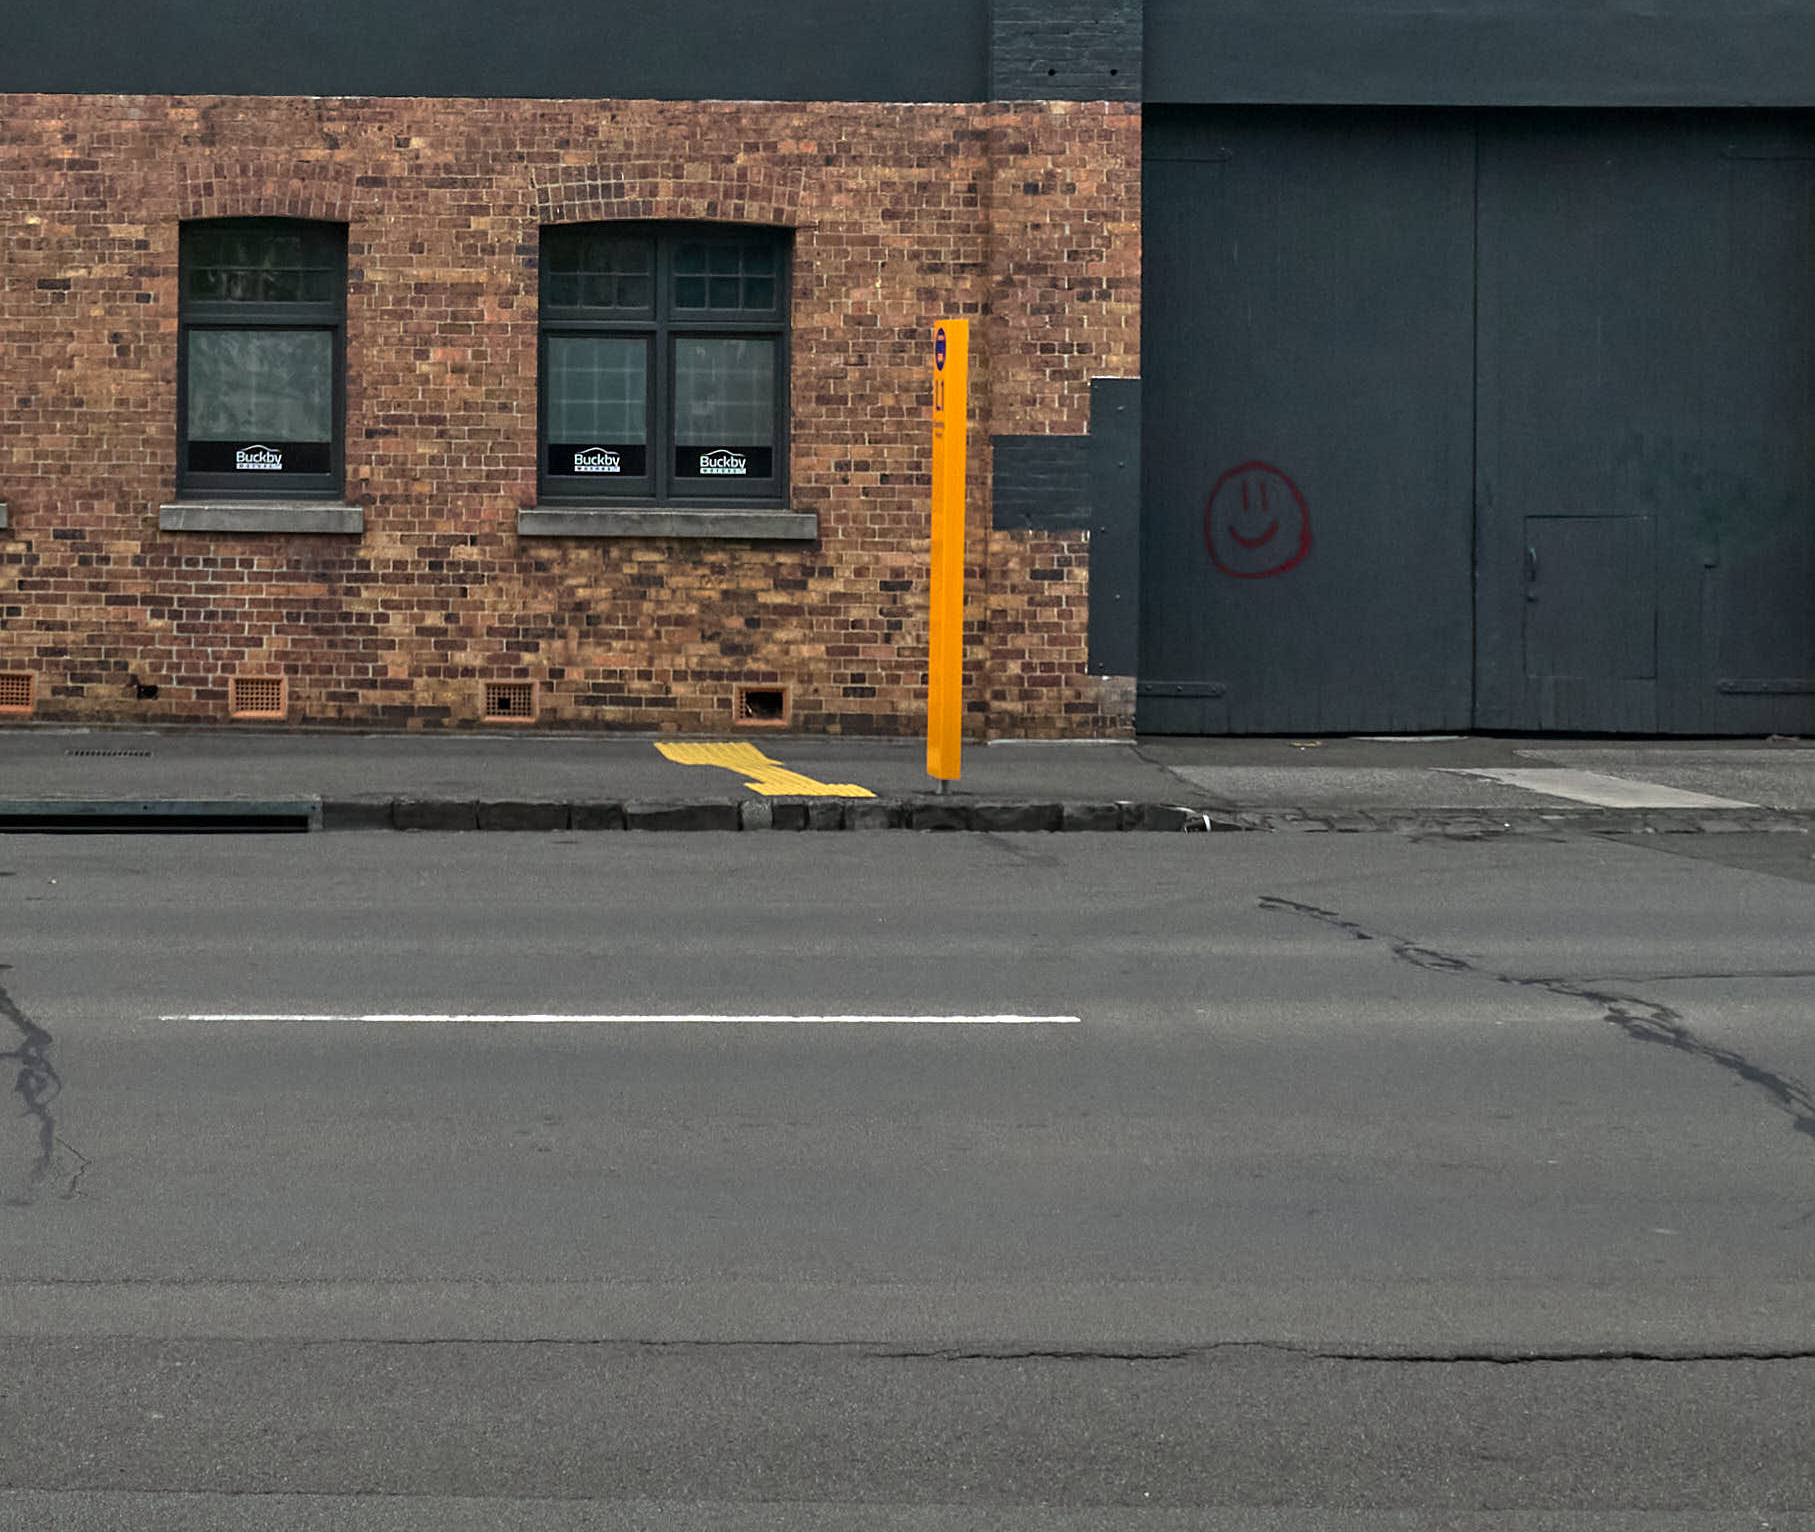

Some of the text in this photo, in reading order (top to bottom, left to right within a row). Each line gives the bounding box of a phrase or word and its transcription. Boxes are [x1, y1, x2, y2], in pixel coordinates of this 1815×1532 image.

[236, 451, 282, 465] Buckby
[574, 453, 620, 467] Buckby
[700, 455, 746, 469] Buckby
